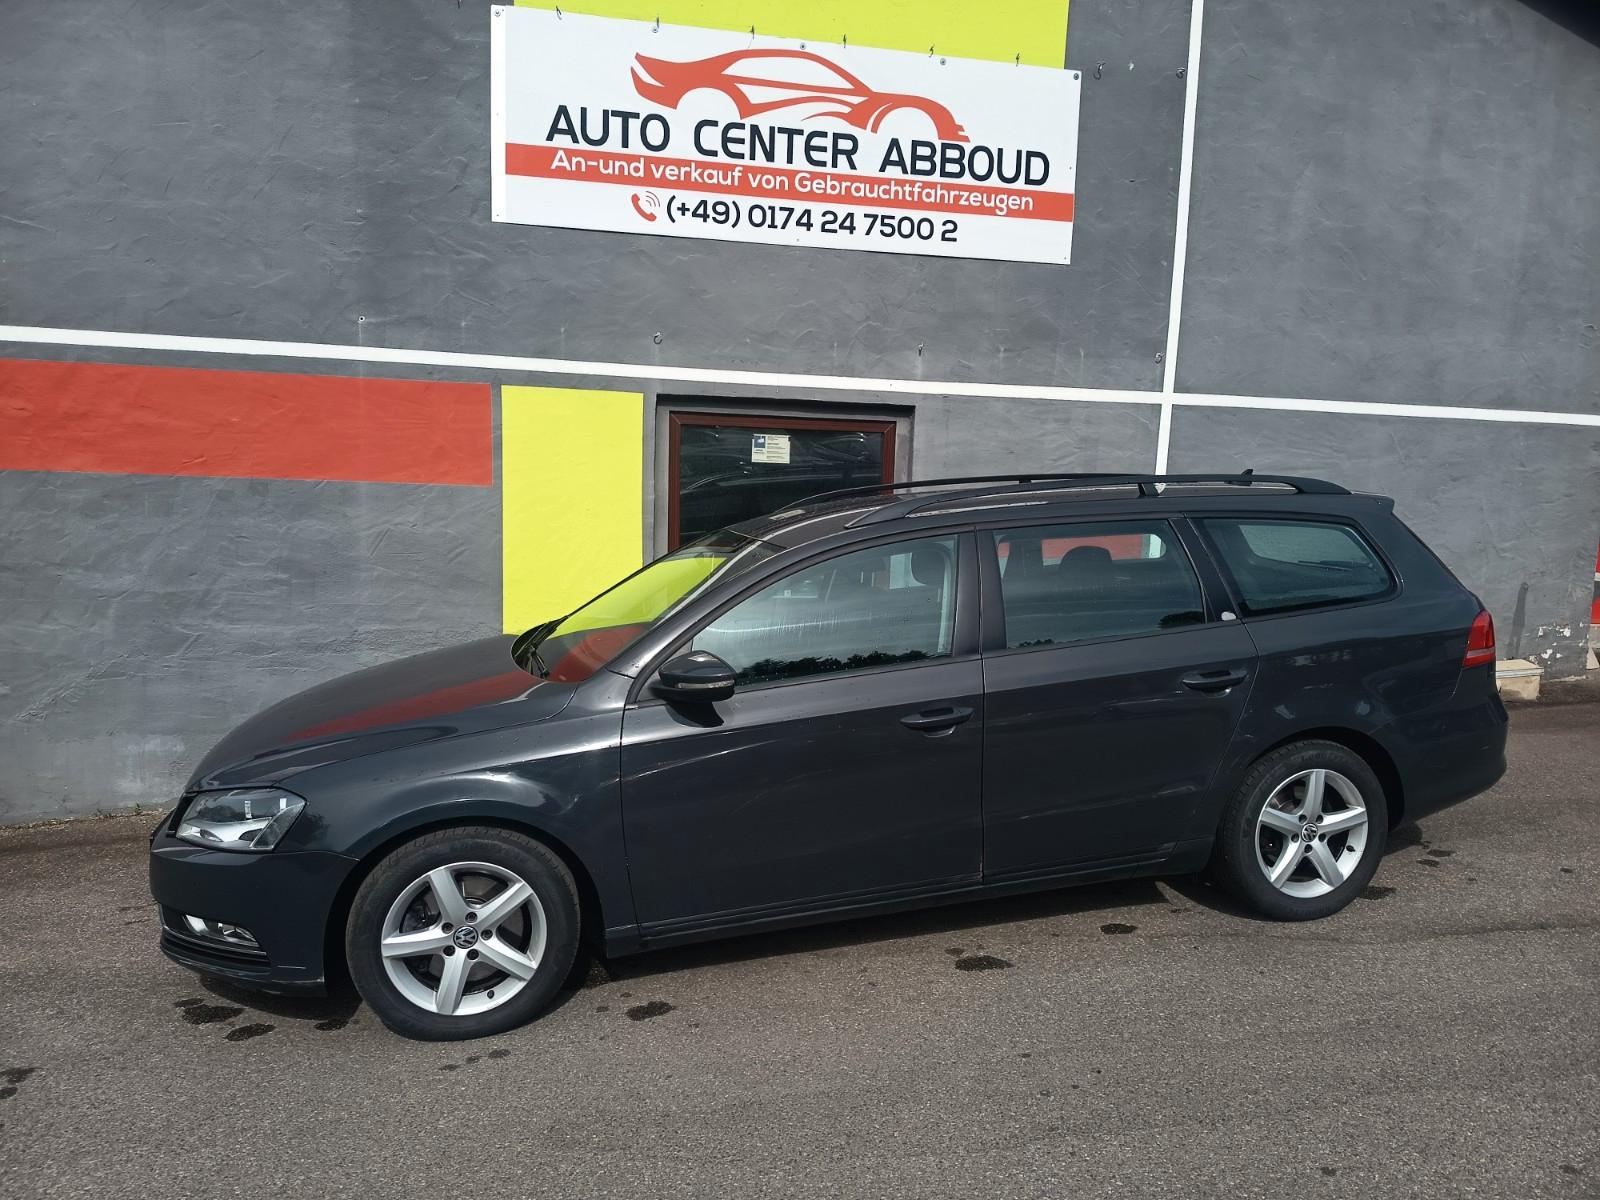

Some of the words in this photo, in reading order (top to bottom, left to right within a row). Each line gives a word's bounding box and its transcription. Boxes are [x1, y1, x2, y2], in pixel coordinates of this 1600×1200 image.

[545, 104, 672, 153] AUTO
[693, 119, 859, 171] CENTER
[878, 137, 1051, 186] ABBOUD
[550, 149, 645, 178] An-und
[650, 161, 744, 187] verkauf
[747, 172, 789, 191] von
[794, 171, 1035, 214] Gebrauchtfahrzeugen
[666, 194, 742, 229] (+49)
[747, 204, 814, 232] 0174
[820, 210, 857, 235] 24
[863, 213, 936, 241] 7500
[940, 219, 959, 243] 2
